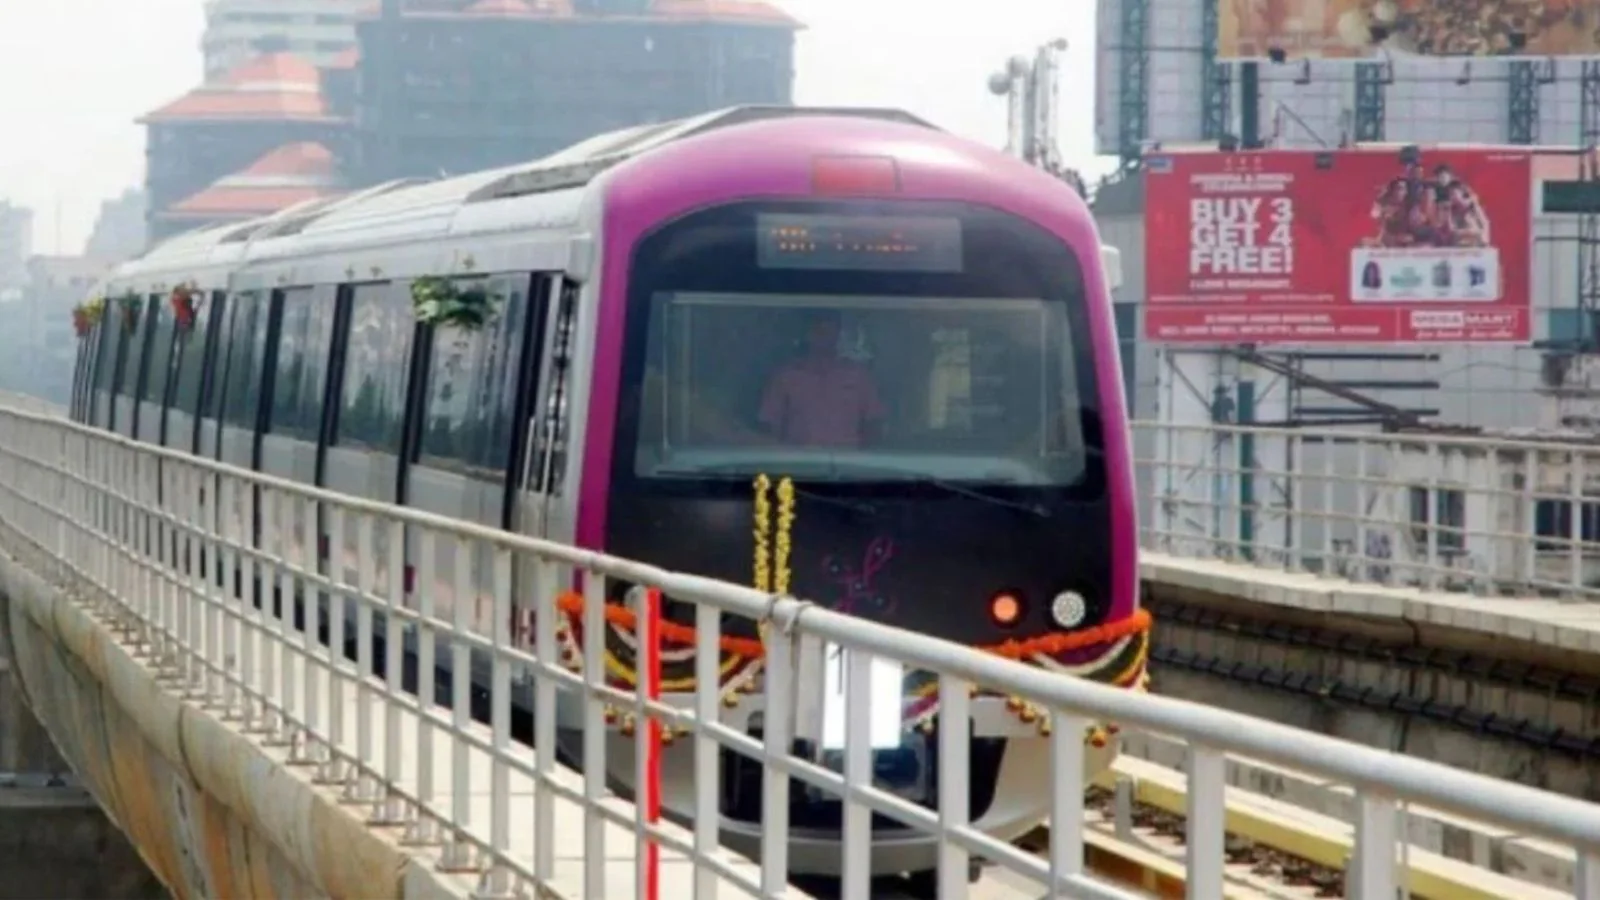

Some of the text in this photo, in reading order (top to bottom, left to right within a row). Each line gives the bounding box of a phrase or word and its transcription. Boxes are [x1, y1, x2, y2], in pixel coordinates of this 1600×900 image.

[1190, 198, 1293, 221] BUY 3
[1190, 221, 1293, 246] GET 4
[1190, 246, 1293, 273] FREE!
